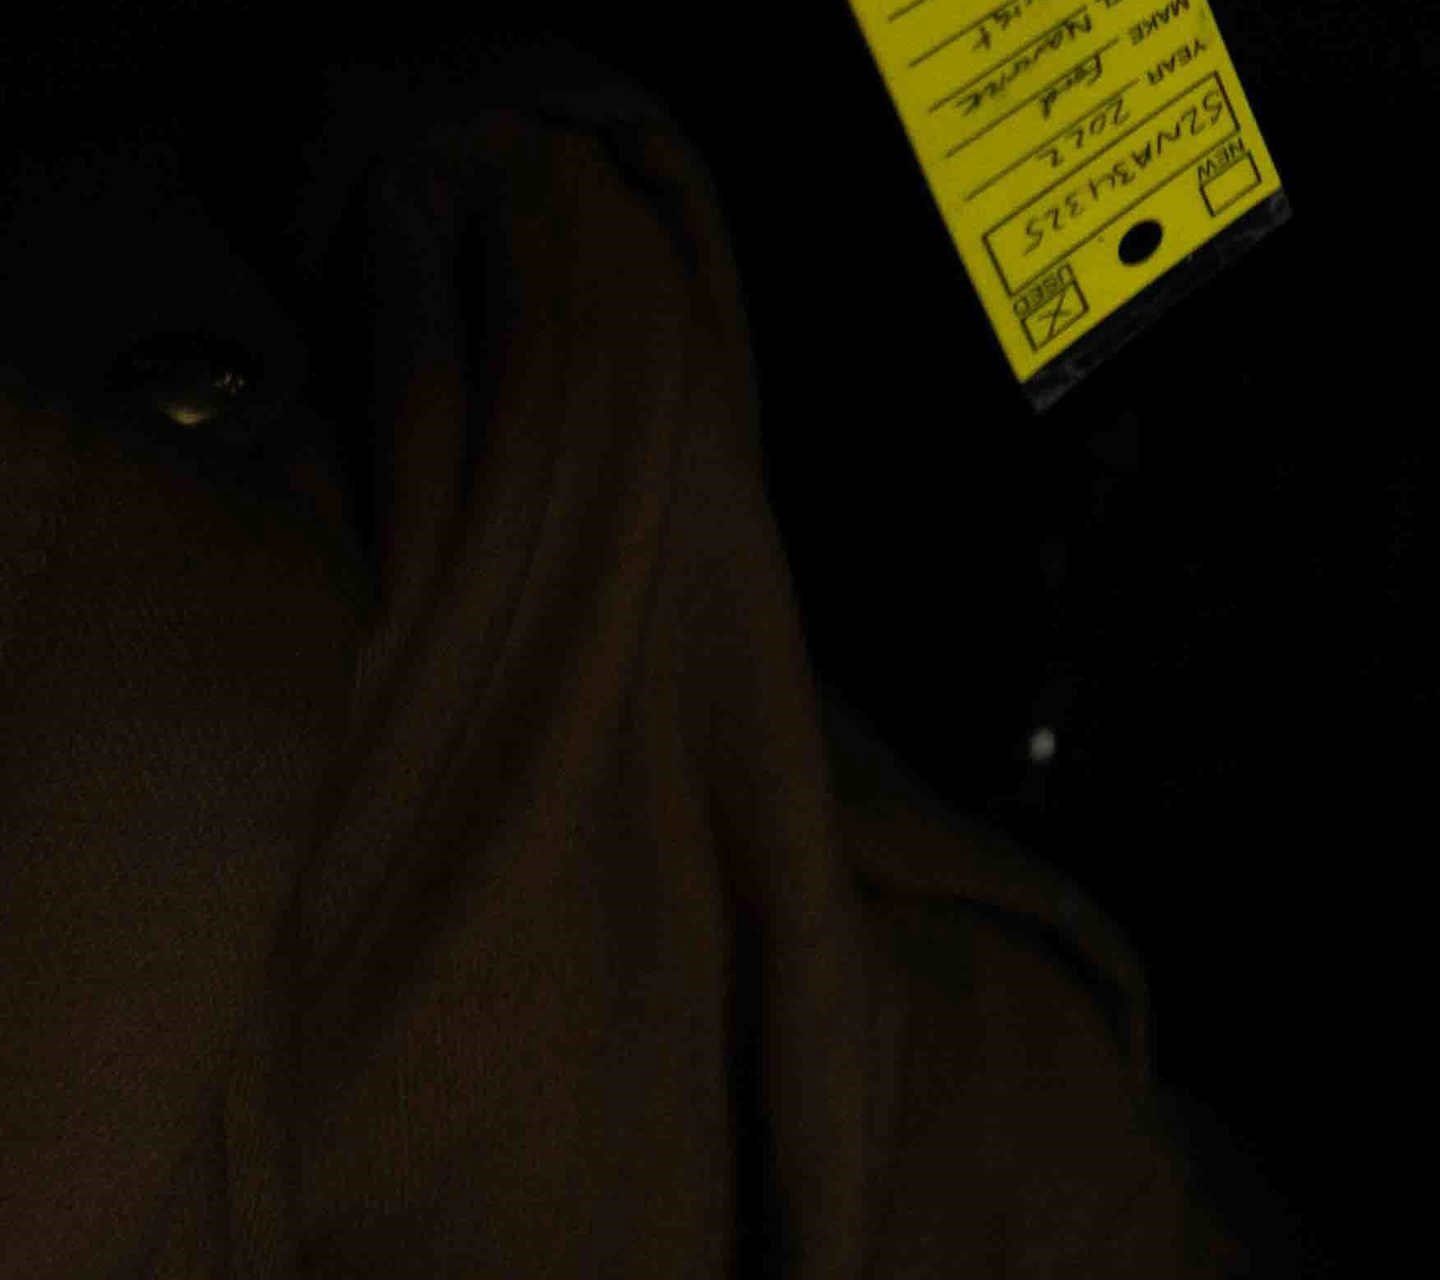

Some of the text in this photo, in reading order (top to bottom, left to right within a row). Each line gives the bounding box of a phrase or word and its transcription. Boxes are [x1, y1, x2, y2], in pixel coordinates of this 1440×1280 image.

[1144, 39, 1207, 85] YEAR
[1195, 137, 1247, 183] NEW
[1012, 266, 1075, 319] USED
